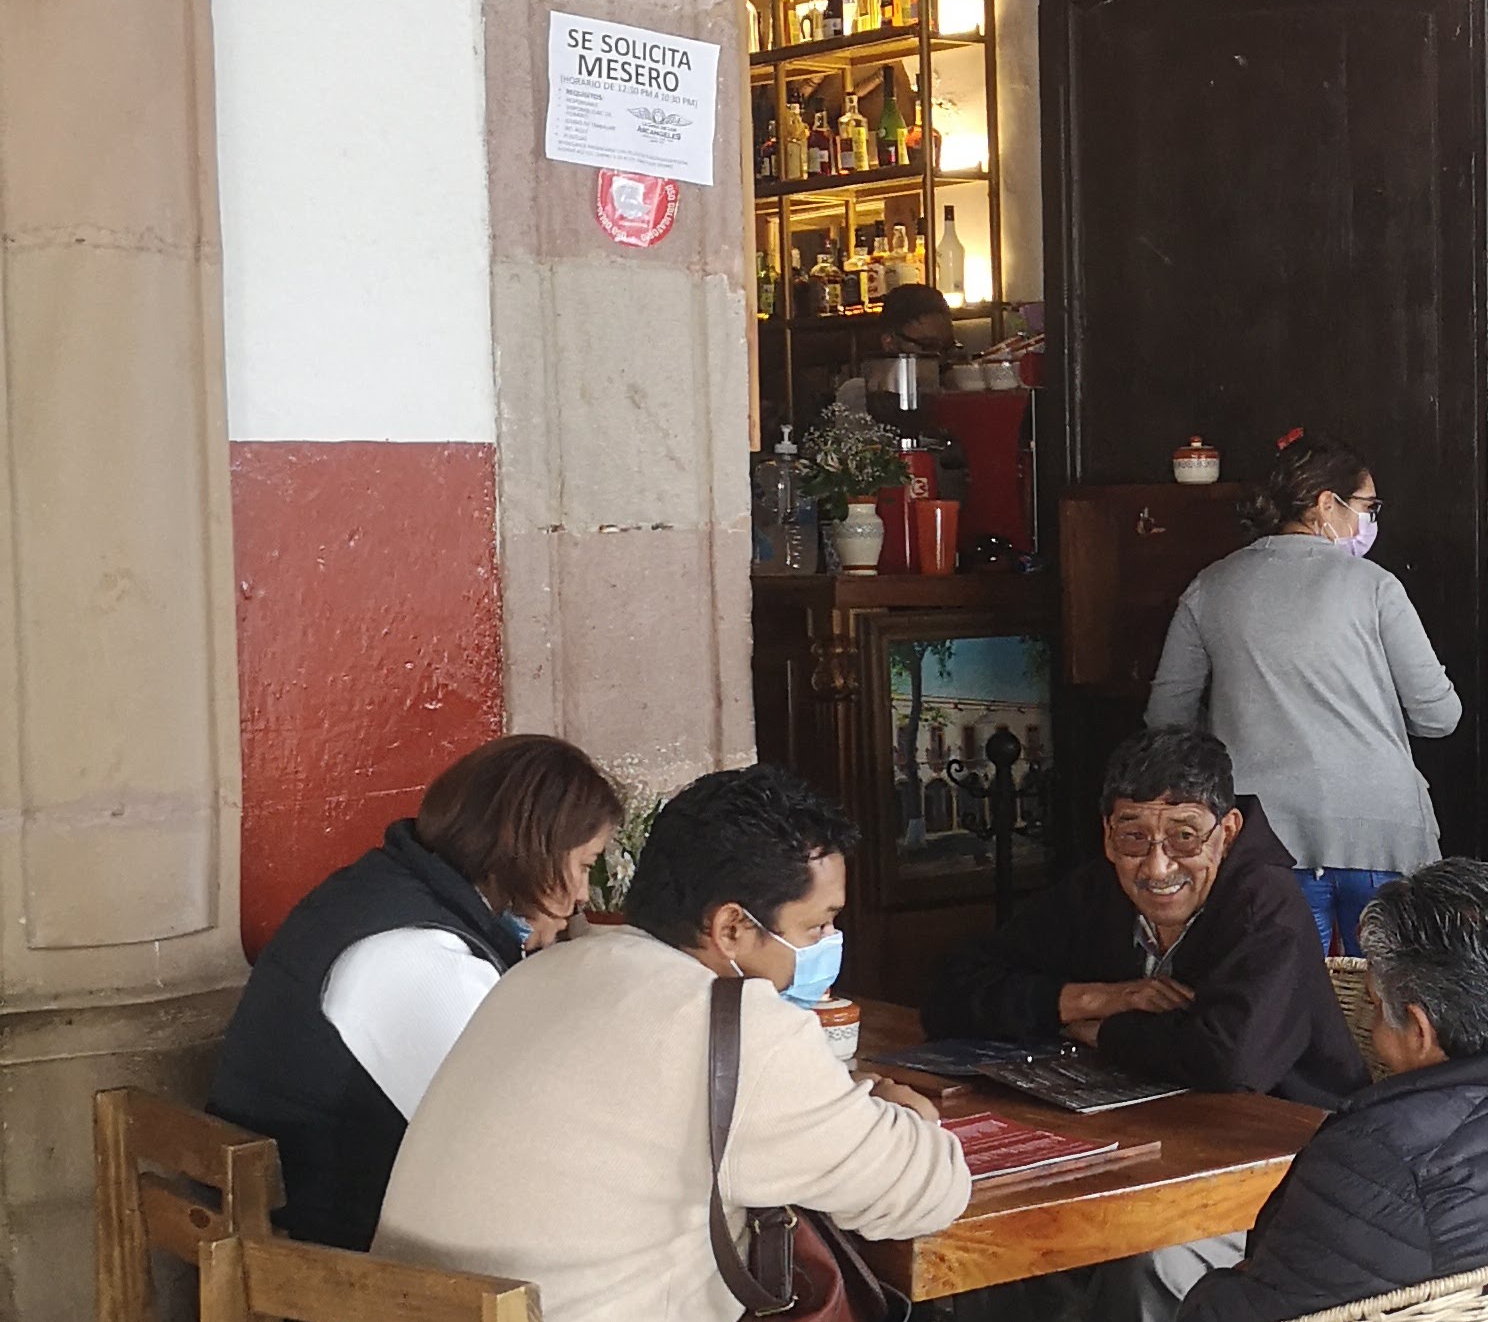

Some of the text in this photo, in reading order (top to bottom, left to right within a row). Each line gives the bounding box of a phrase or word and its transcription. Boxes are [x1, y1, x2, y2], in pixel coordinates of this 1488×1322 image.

[567, 28, 692, 71] SE SOLICITA
[578, 54, 679, 93] MESERO
